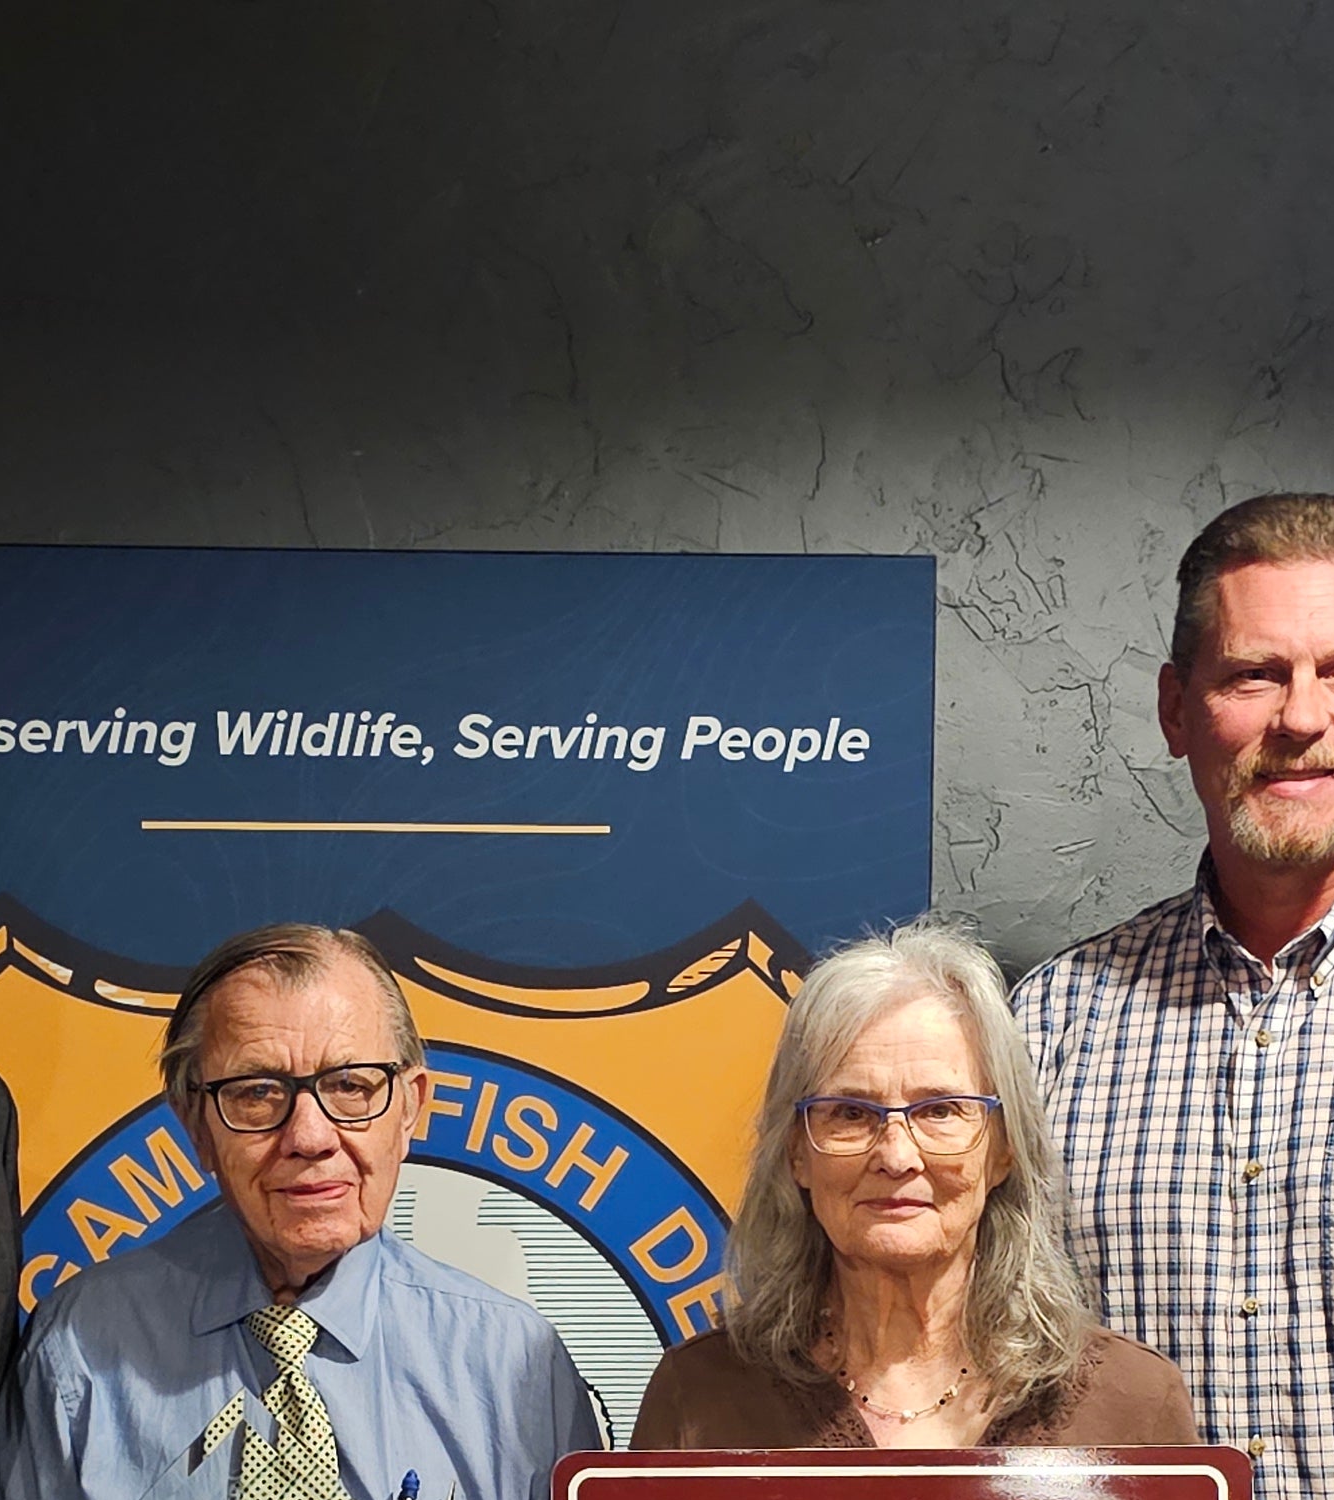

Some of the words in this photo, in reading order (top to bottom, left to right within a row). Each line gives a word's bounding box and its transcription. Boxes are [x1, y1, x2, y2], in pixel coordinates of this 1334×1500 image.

[218, 709, 434, 766] Wildlife,
[453, 713, 665, 772] Serving
[681, 717, 870, 773] People
[19, 1126, 216, 1314] GAM
[411, 1069, 630, 1212] FISH
